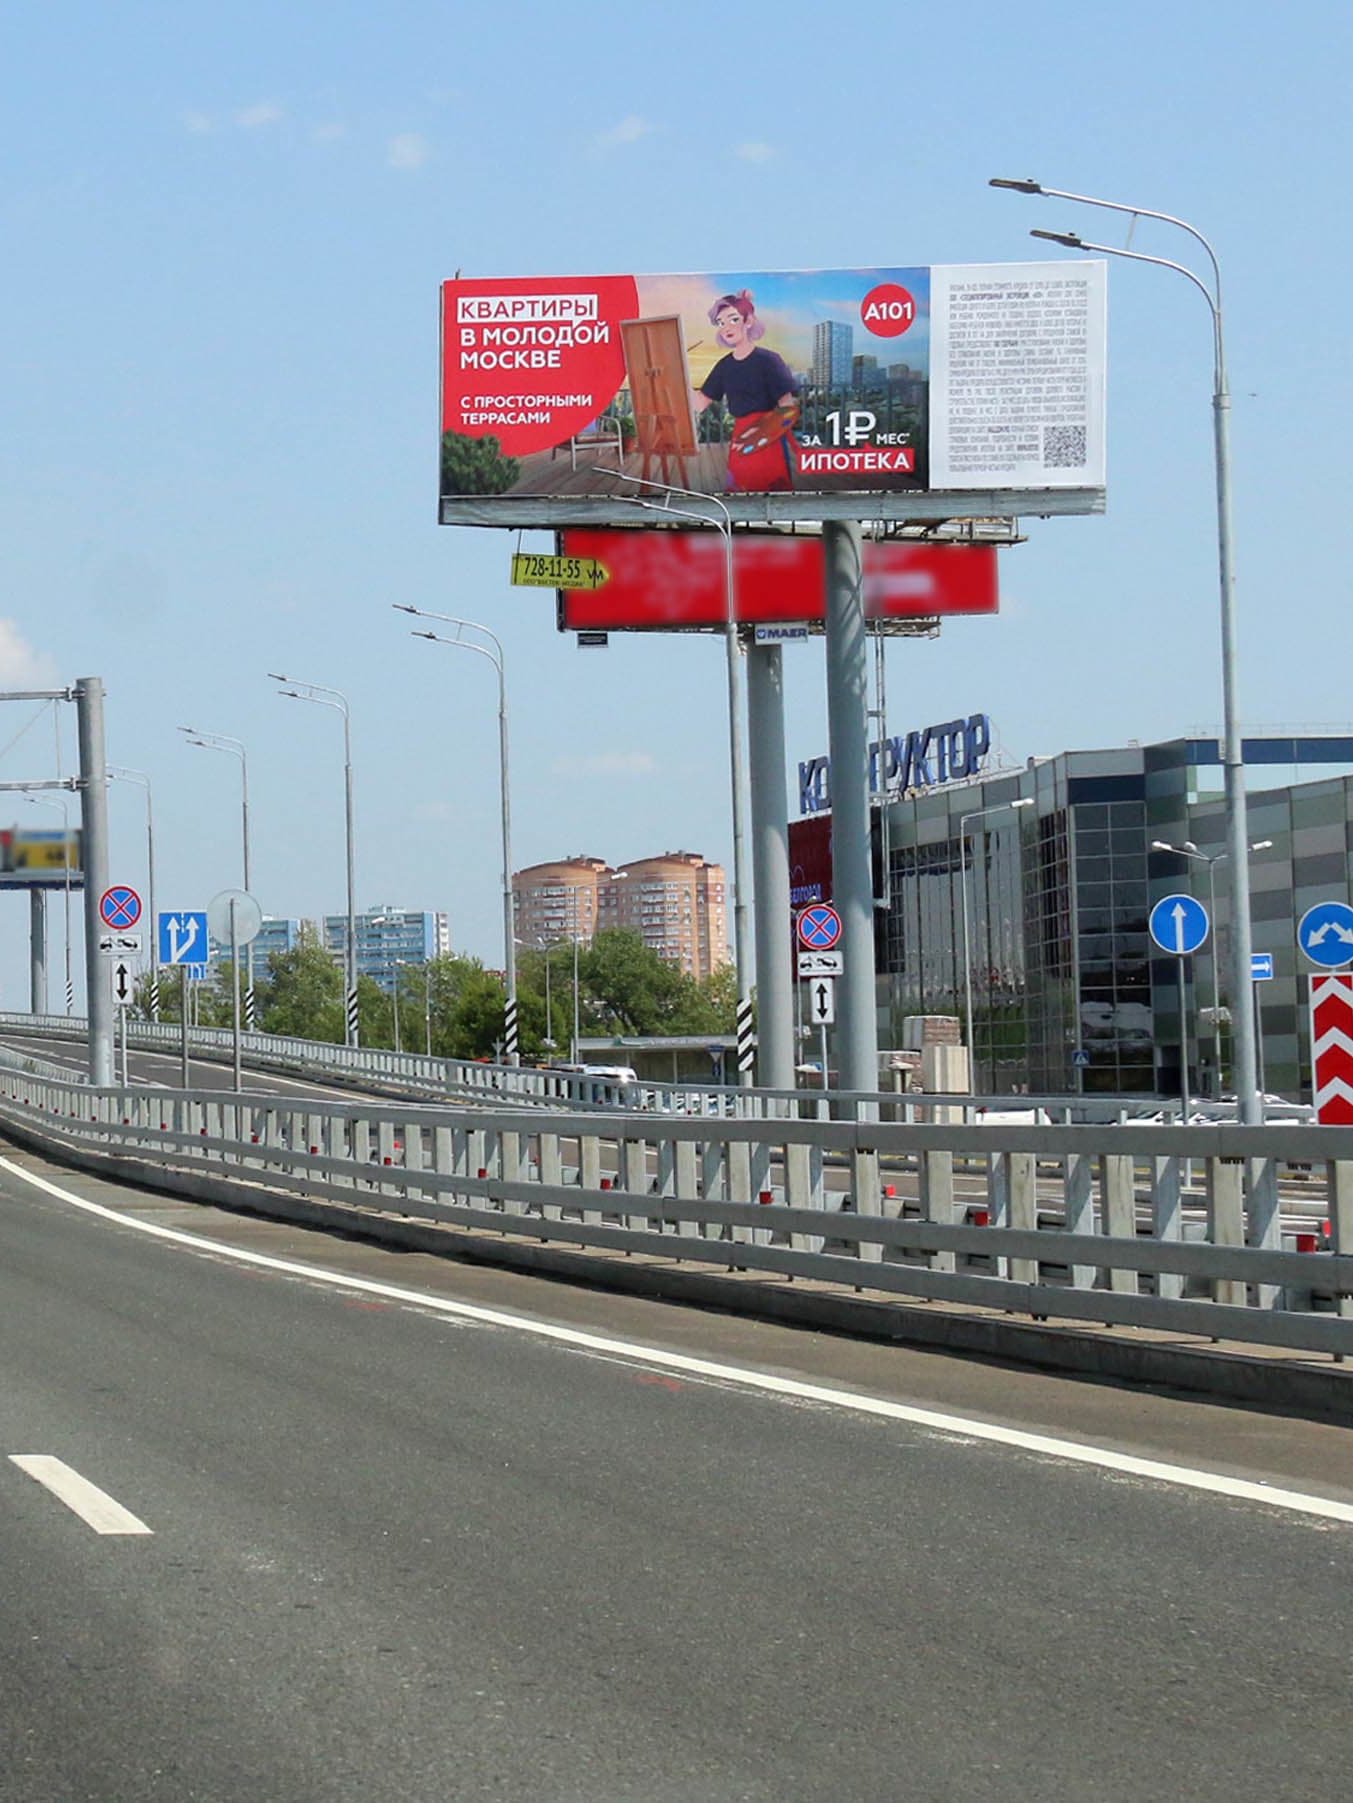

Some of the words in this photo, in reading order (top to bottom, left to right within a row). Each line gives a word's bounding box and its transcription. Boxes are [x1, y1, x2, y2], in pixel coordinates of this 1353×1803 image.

[460, 299, 594, 319] КВАРТИРЫ
[460, 328, 476, 347] В
[482, 321, 610, 347] МОЛОДОЙ
[460, 350, 562, 370] МОСКВЕ
[460, 396, 472, 409] С
[474, 394, 593, 408] ПРОСТОРНЫМИ
[460, 412, 551, 425] ТЕРРАСАМИ
[801, 434, 822, 447] ЗА
[801, 452, 910, 471] ИПОТЕКА
[524, 557, 581, 579] 728-11-55
[767, 628, 807, 639] MAER
